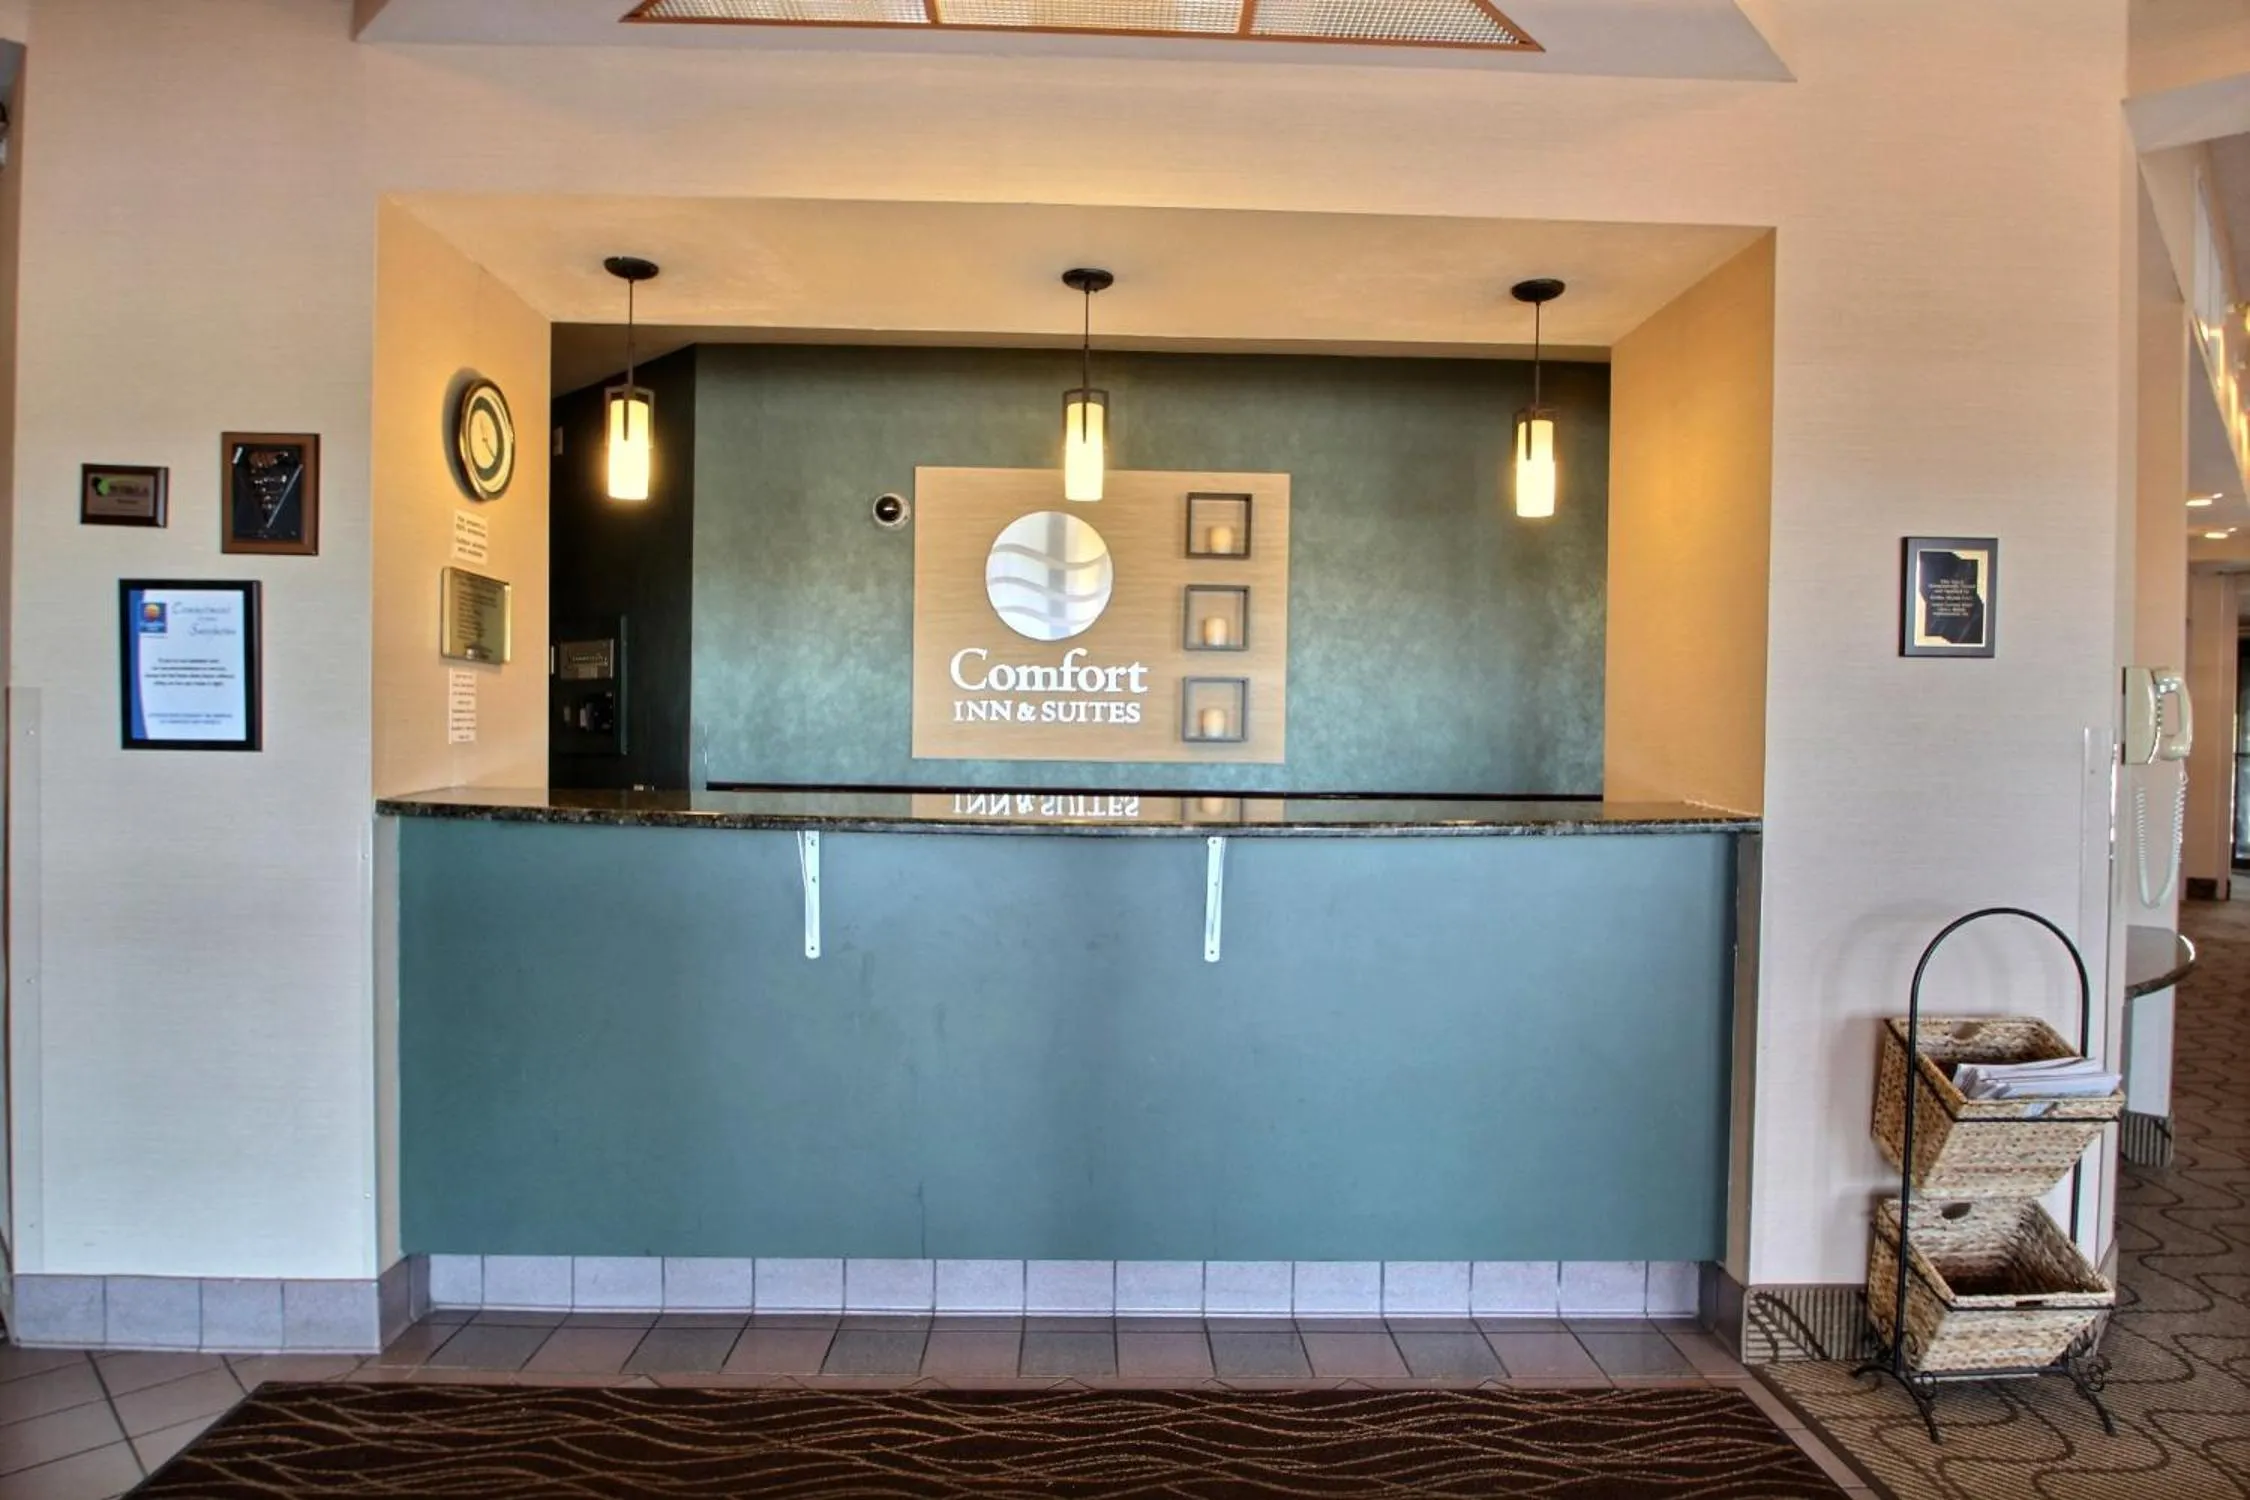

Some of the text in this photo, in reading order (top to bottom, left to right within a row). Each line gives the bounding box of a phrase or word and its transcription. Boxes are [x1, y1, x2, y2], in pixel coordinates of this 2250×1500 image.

[950, 647, 1148, 693] Comfort
[953, 700, 1141, 723] INN & SUITES
